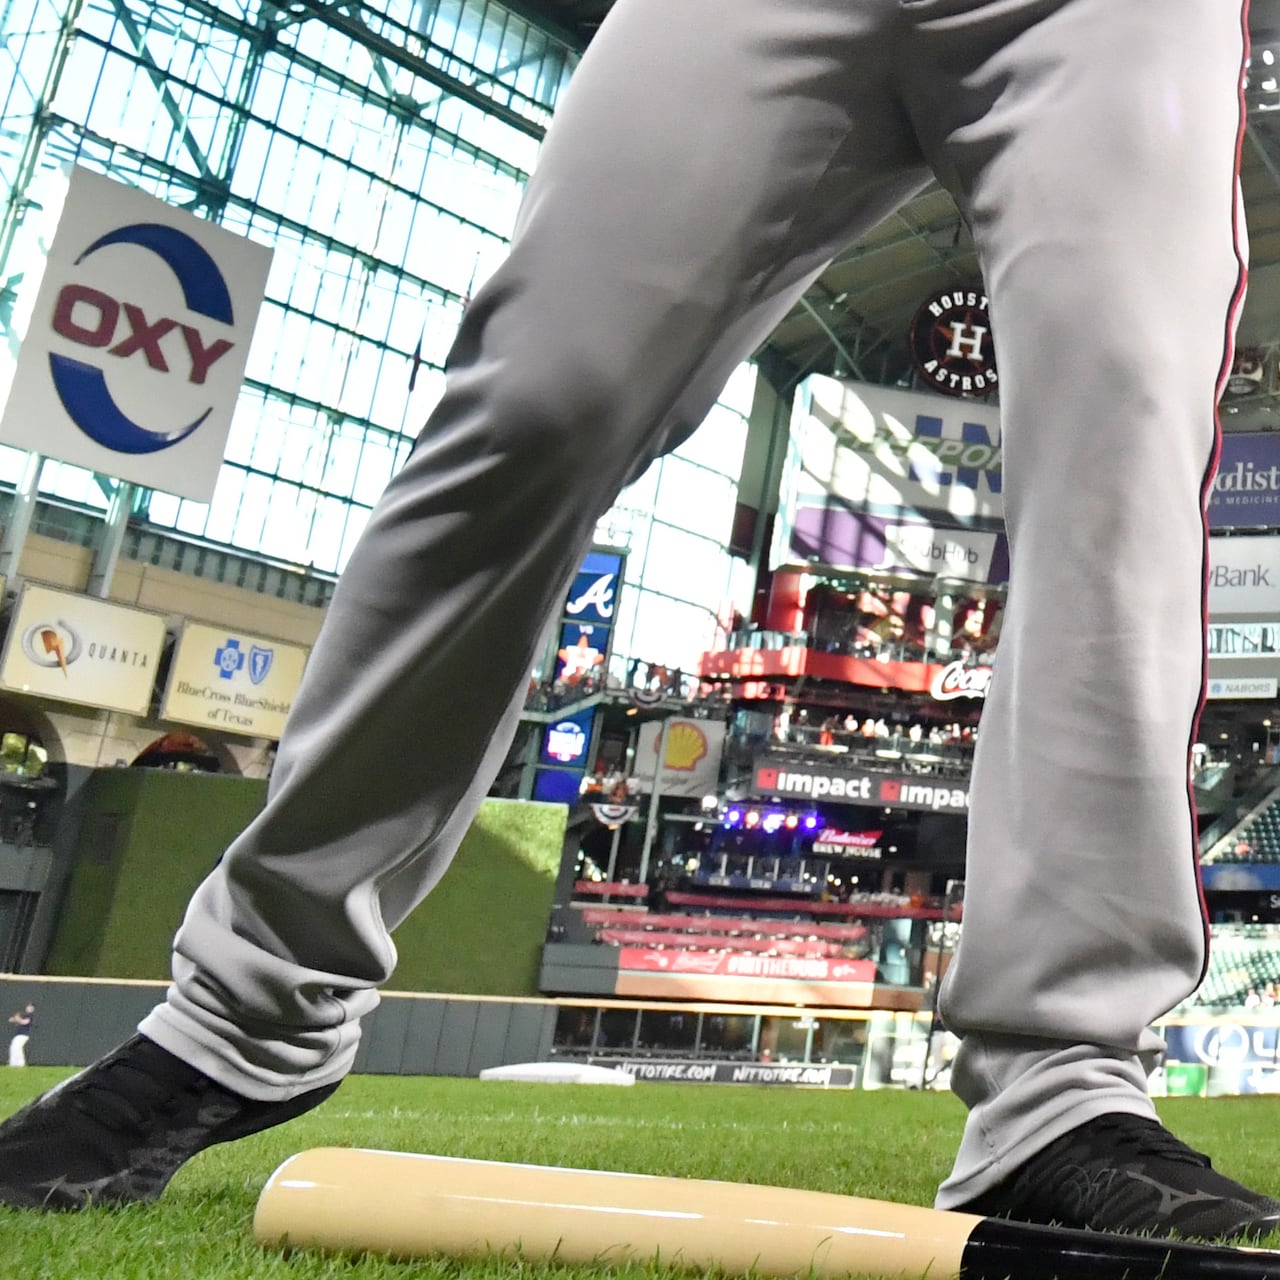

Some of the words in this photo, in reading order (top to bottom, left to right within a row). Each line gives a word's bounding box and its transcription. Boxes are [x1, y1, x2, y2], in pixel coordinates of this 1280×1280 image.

[929, 292, 989, 317] HOUST
[52, 283, 235, 385] OXY
[946, 321, 987, 361] H
[924, 360, 998, 391] ASTROS
[1214, 461, 1280, 492] odist
[1225, 495, 1280, 505] MEDICINE
[88, 642, 149, 669] QUANTA
[176, 681, 231, 703] BlueCross
[233, 693, 291, 715] BlueShield
[1224, 683, 1271, 694] NABORS
[207, 708, 221, 721] of
[222, 709, 254, 726] Texas
[777, 767, 872, 799] impact
[900, 780, 970, 810] impa
